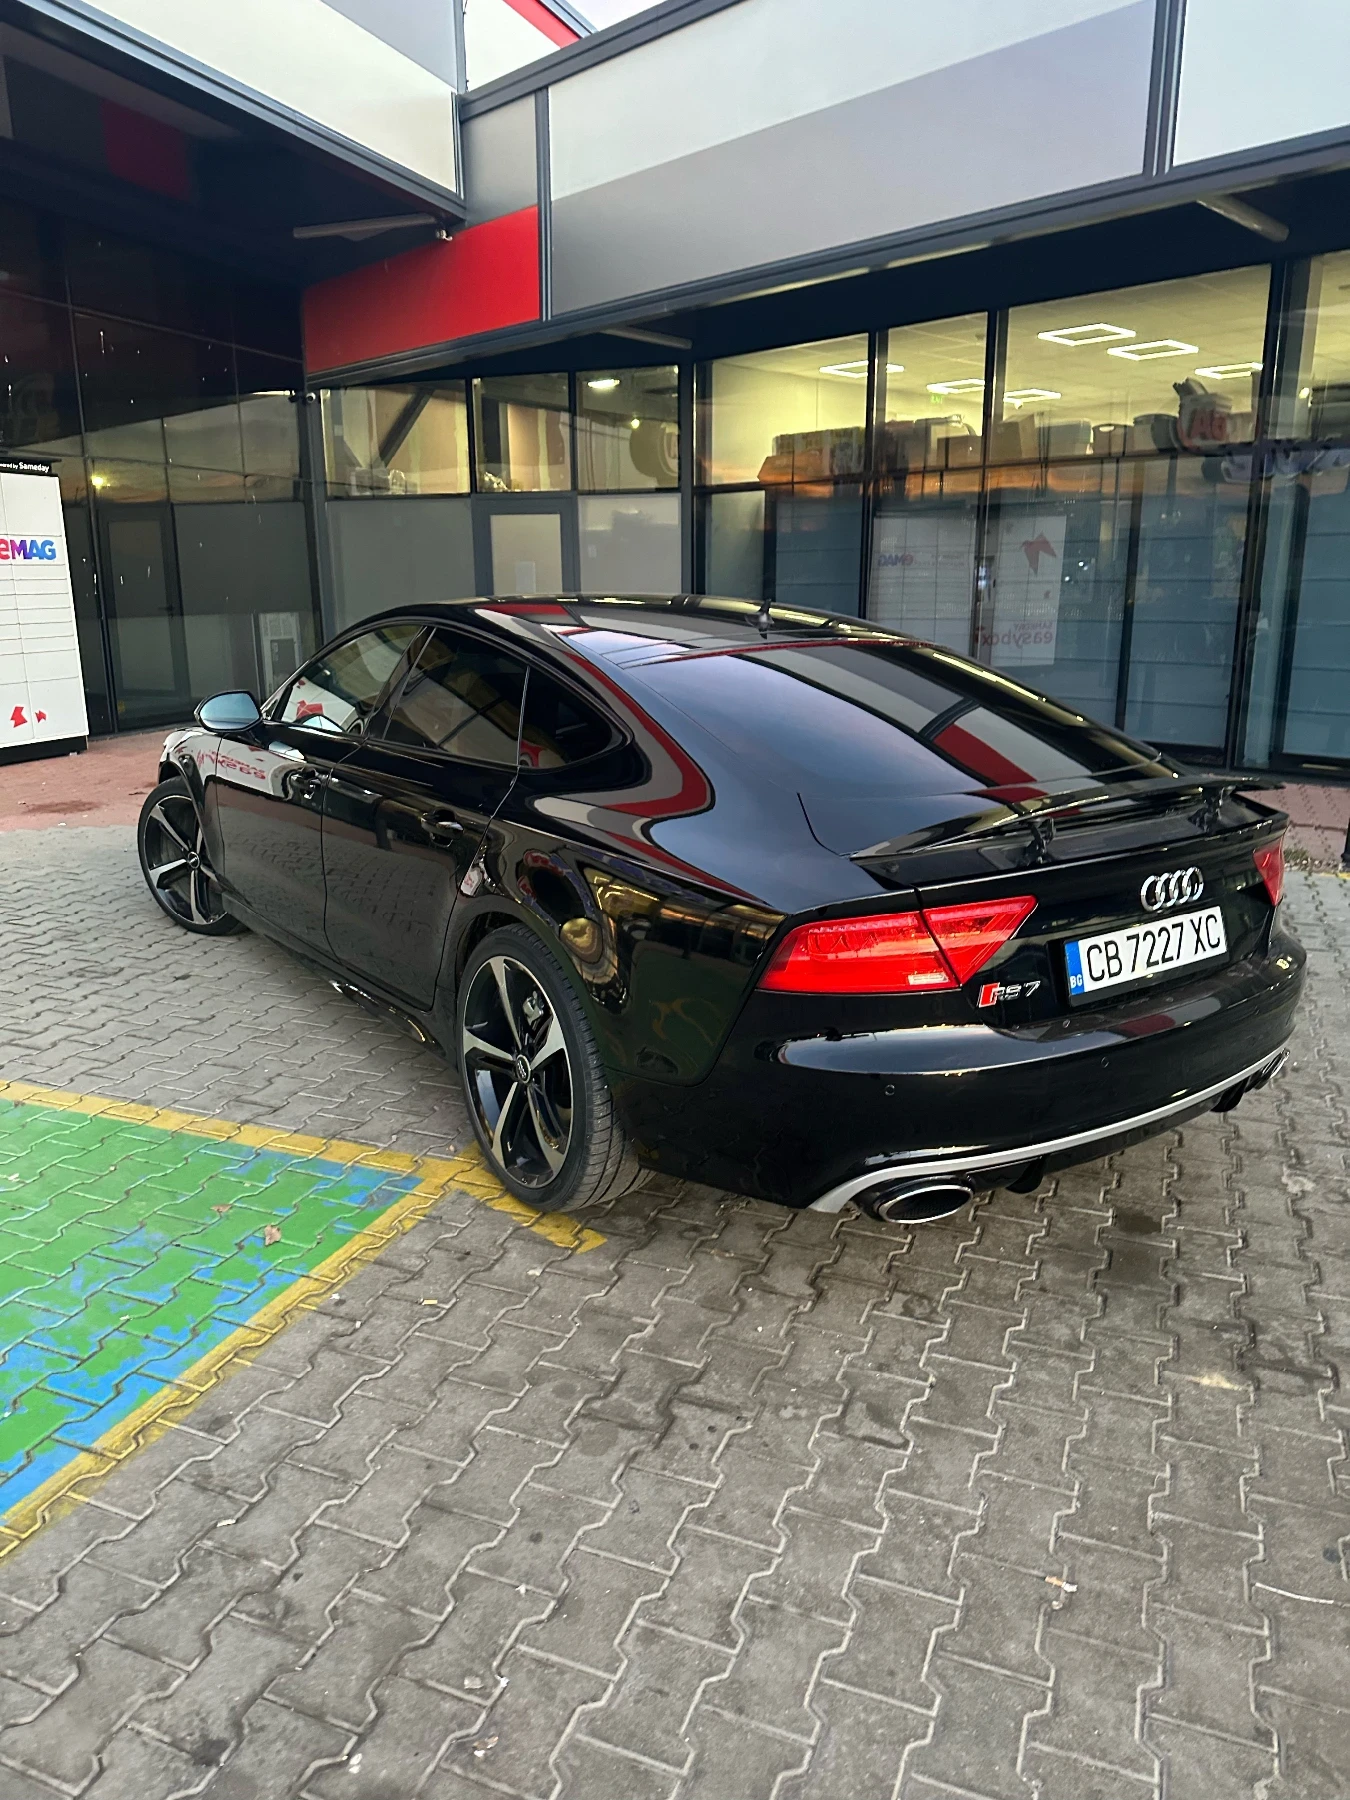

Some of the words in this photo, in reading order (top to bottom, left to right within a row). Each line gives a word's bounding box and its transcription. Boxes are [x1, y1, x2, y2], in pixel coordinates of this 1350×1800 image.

[19, 461, 49, 473] Sameday
[0, 539, 56, 560] eMAG
[1086, 940, 1122, 982] CB
[1126, 922, 1183, 973] 7227
[1190, 914, 1220, 955] XC
[1070, 974, 1083, 988] BG
